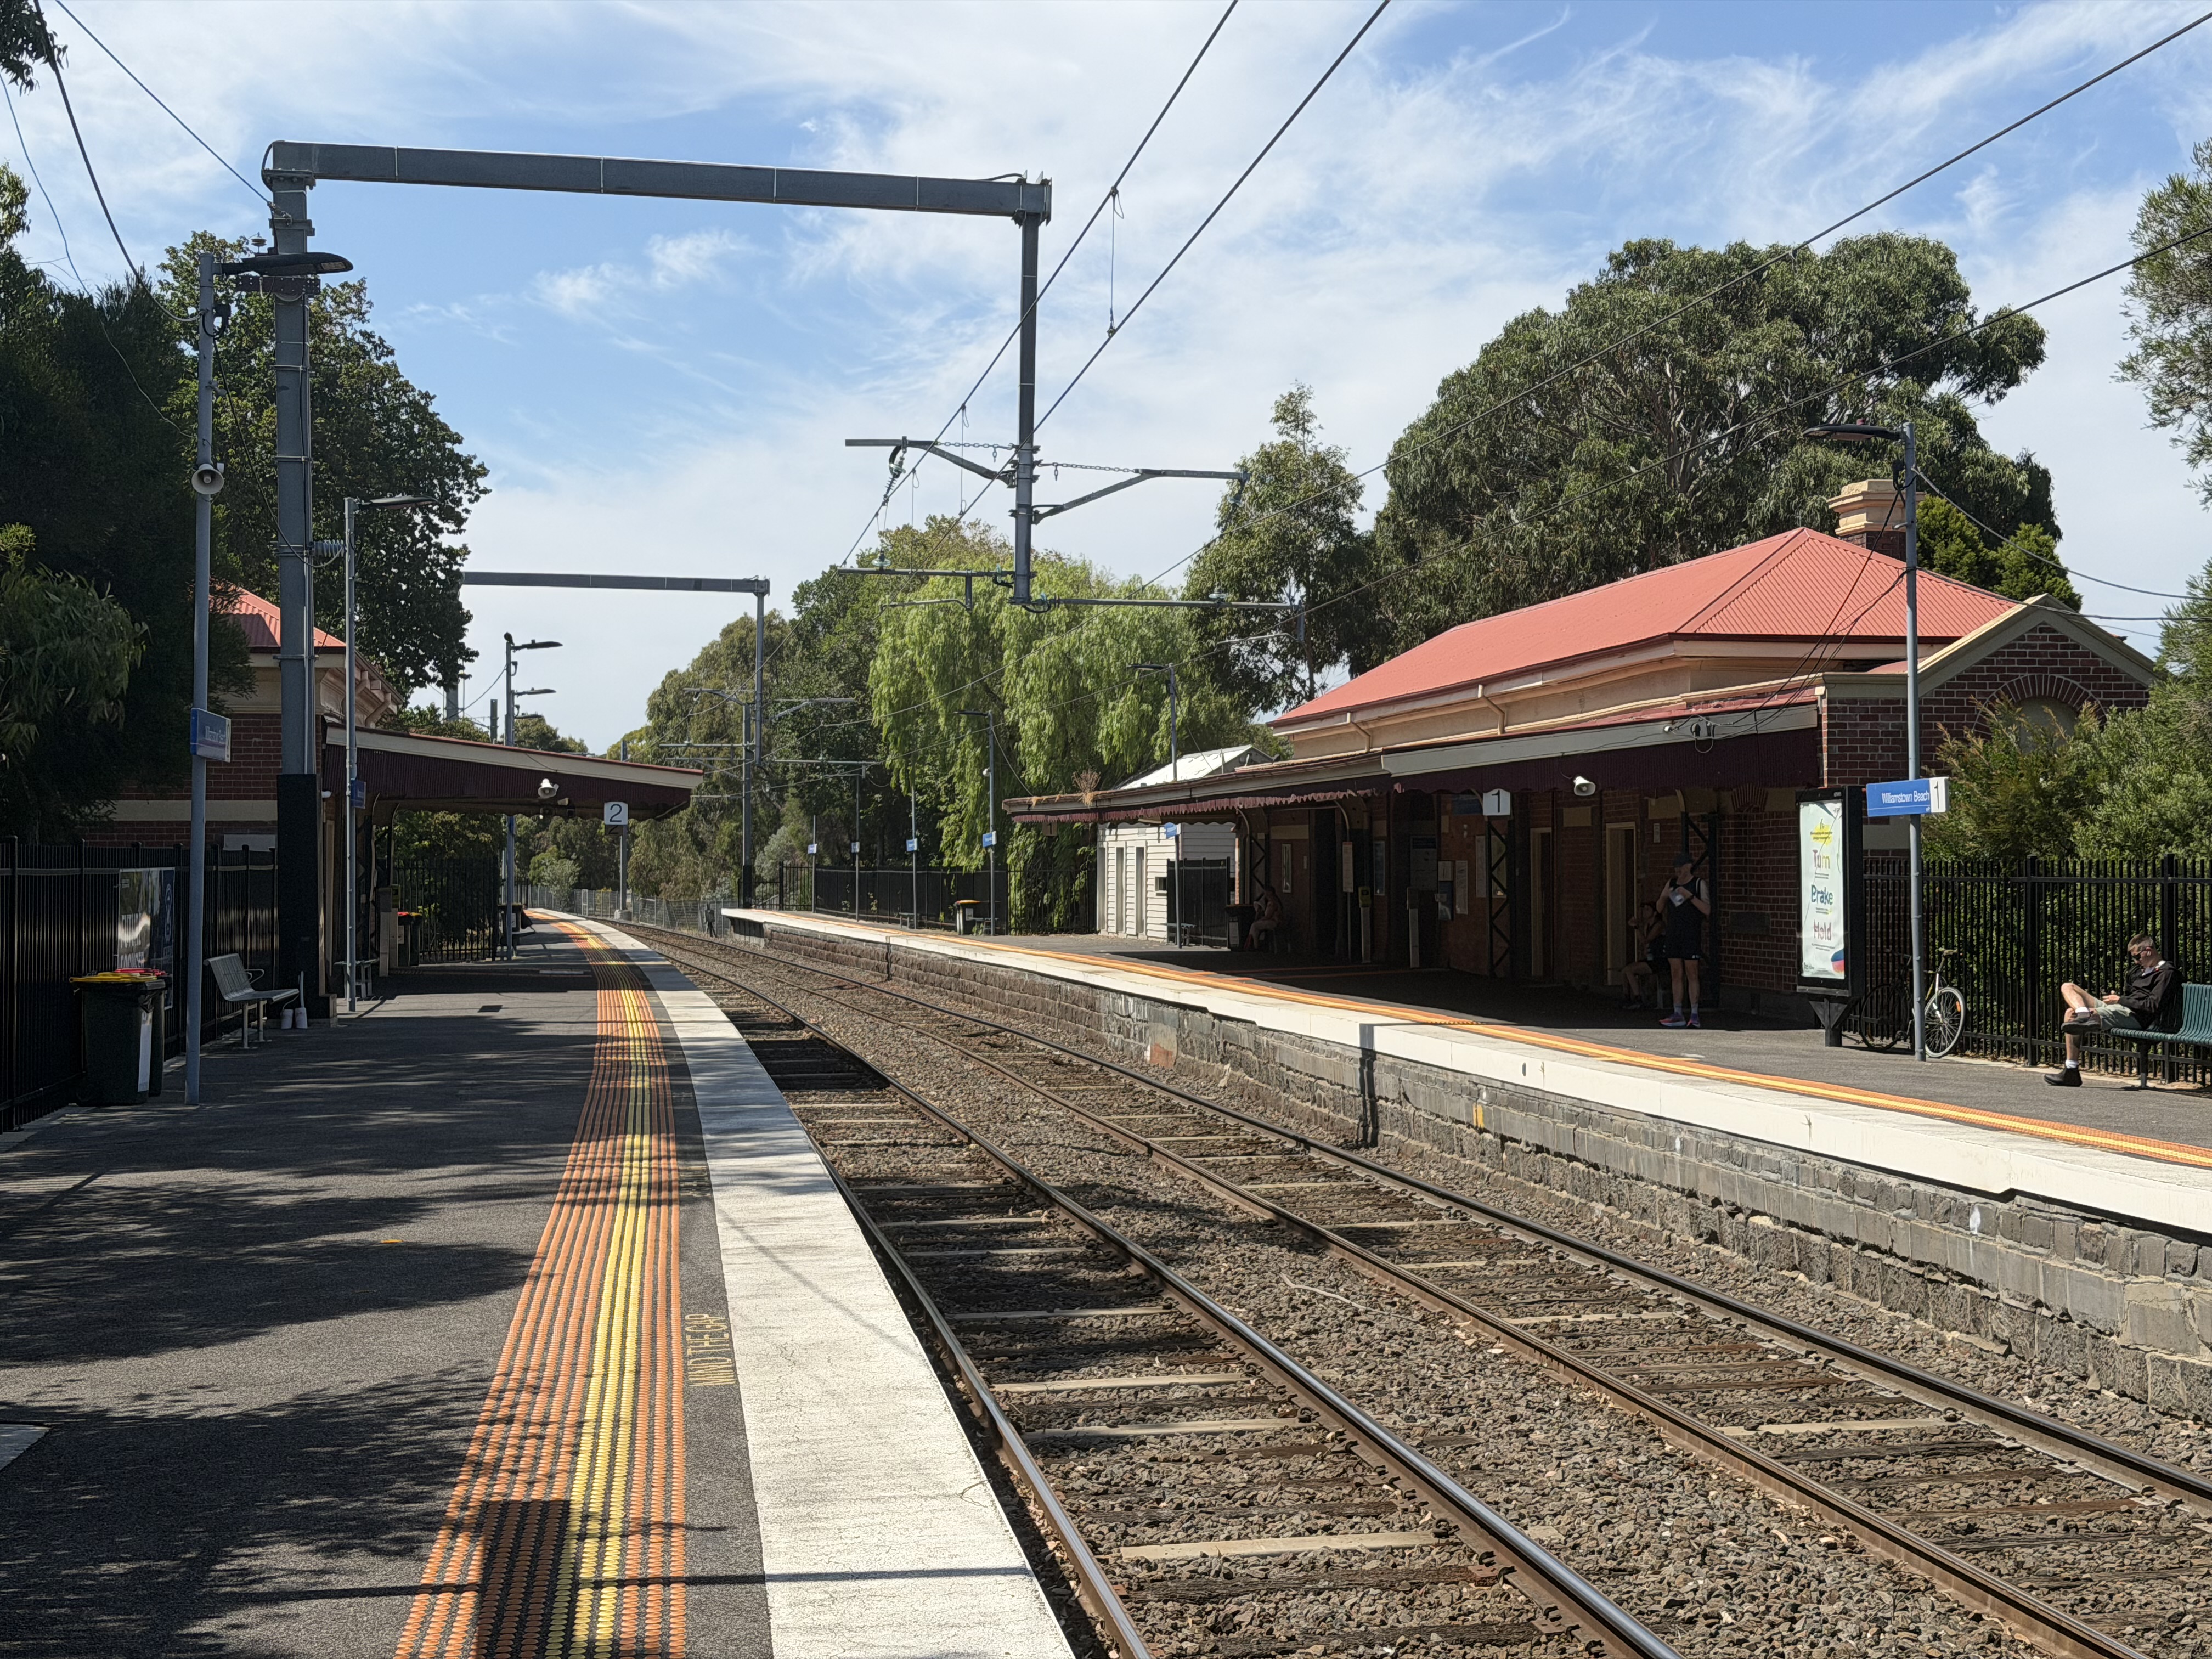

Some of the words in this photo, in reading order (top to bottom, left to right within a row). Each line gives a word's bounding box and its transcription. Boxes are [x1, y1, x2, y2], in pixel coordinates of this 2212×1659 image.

[1491, 790, 1500, 813] 1
[1881, 792, 1913, 804] Williamstown
[1914, 790, 1930, 802] Beach
[1934, 781, 1940, 809] 1
[610, 804, 622, 822] 2
[1047, 822, 1052, 834] 1
[1812, 849, 1830, 870] Turn
[1811, 884, 1833, 905] Brake
[1813, 919, 1832, 941] Hold
[685, 1313, 728, 1332] GAP
[686, 1333, 731, 1356] THE
[687, 1357, 735, 1387] MIND
